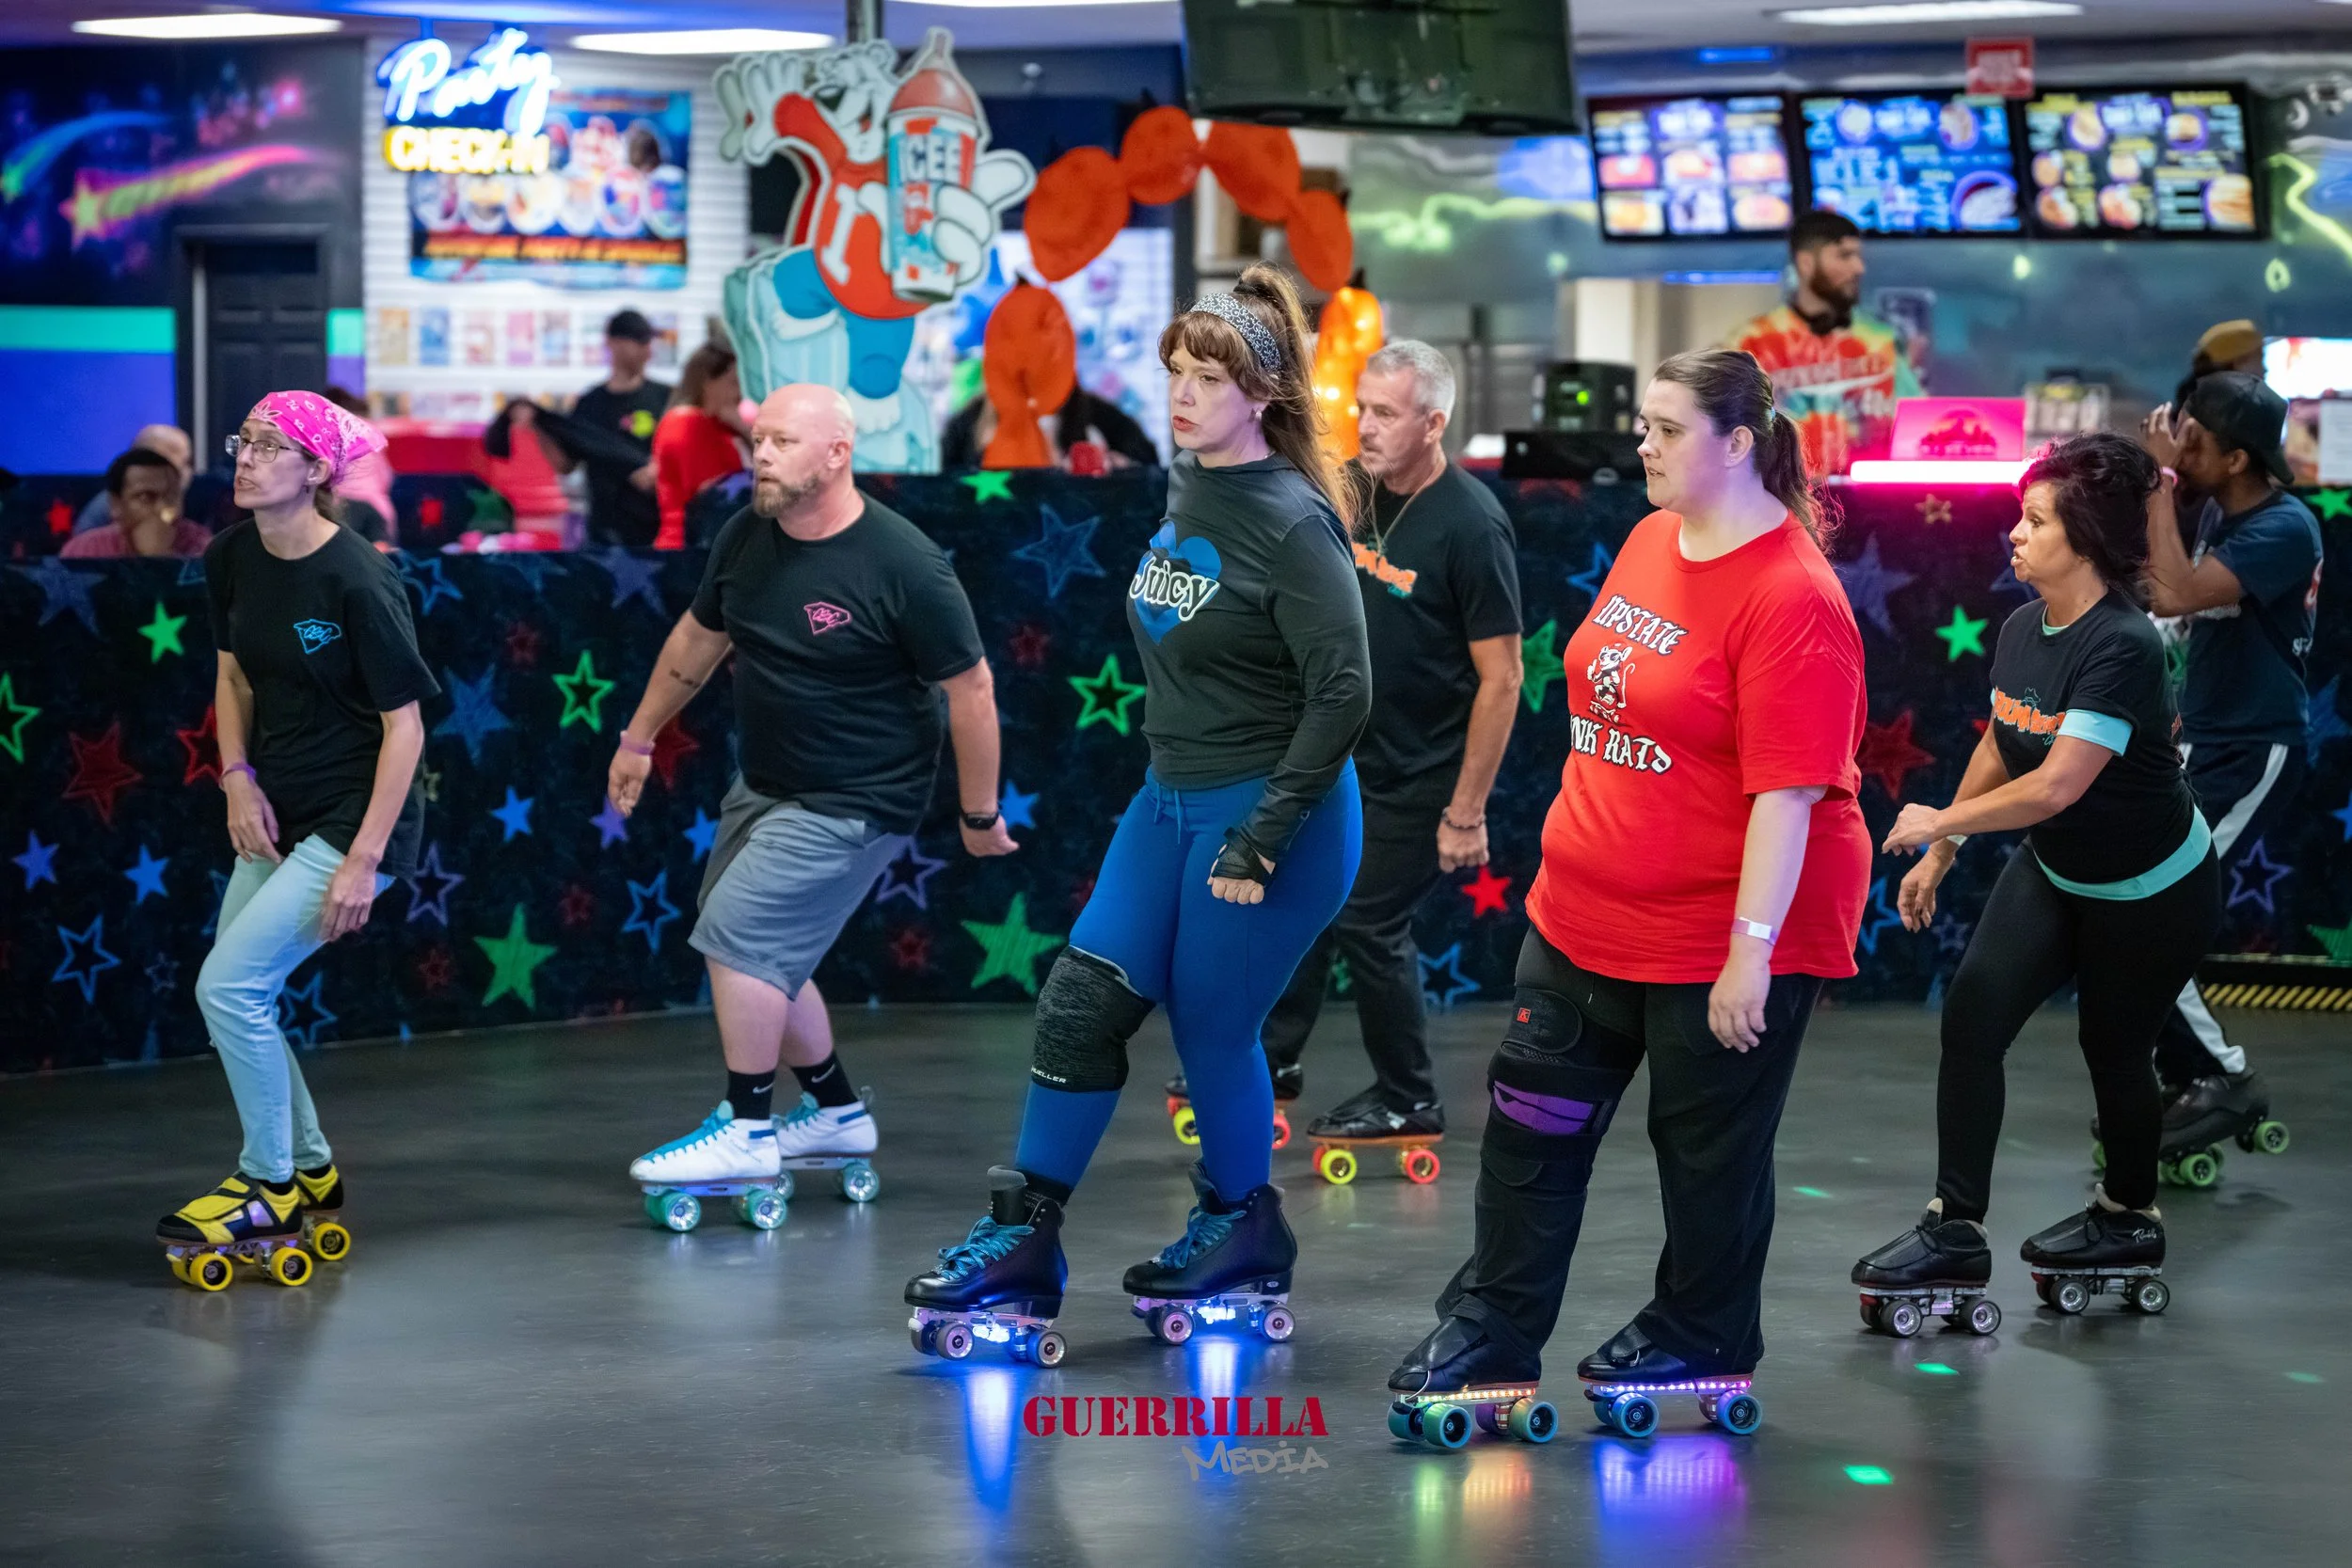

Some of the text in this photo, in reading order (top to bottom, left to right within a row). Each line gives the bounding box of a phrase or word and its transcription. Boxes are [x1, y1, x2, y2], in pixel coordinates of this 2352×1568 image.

[389, 27, 562, 137] Party
[1129, 556, 1220, 622] Juicy
[1593, 594, 1689, 656] UPSTATE
[1602, 727, 1673, 774] RATS
